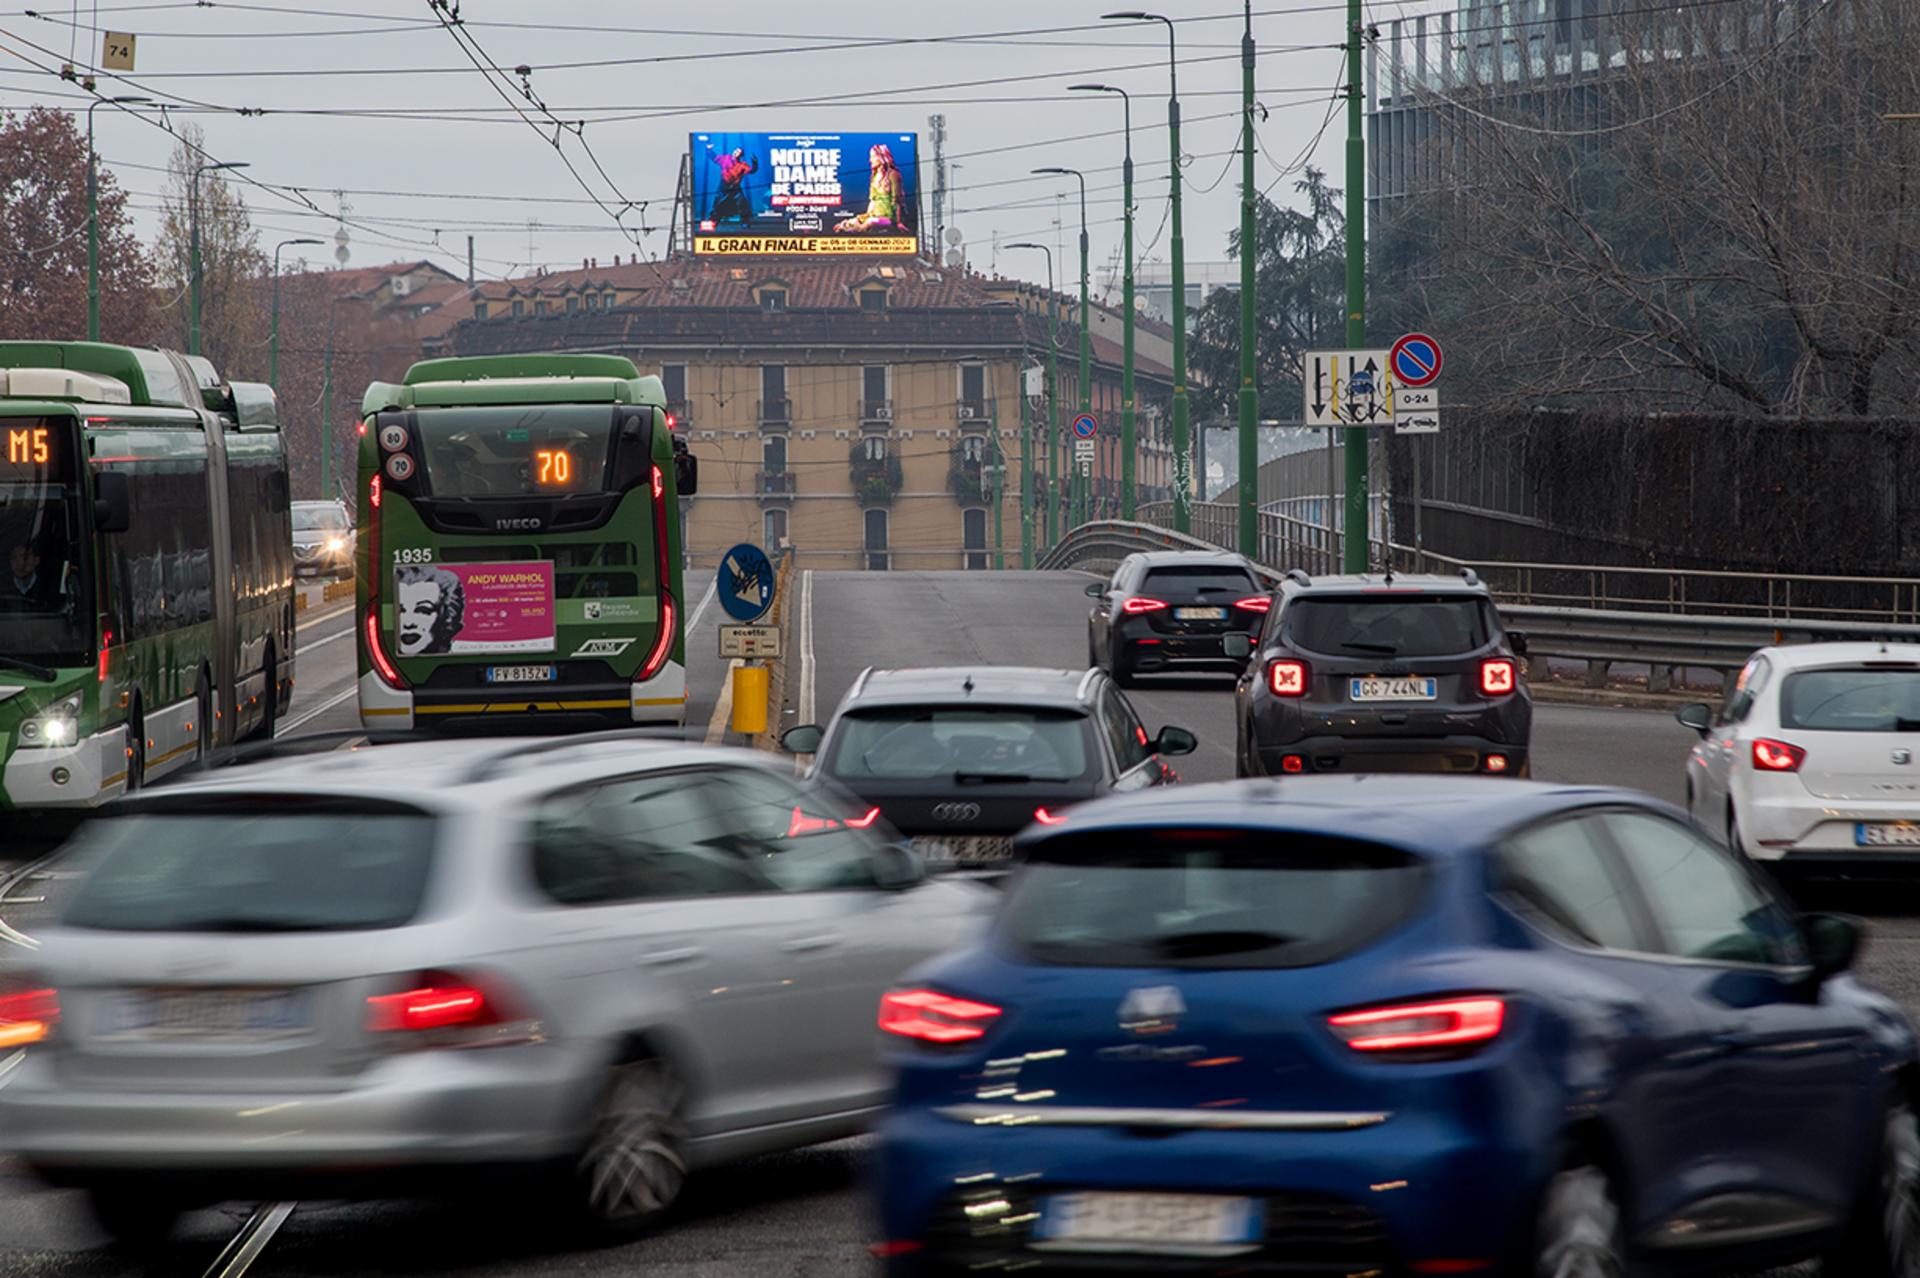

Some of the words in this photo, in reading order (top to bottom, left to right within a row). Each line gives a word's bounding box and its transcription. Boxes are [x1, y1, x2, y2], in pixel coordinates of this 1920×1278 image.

[109, 44, 128, 58] 74
[770, 148, 841, 166] NOTRE
[774, 166, 838, 183] DAME
[771, 183, 791, 195] DE
[794, 183, 841, 195] PARIS
[702, 240, 715, 251] IL
[718, 240, 760, 252] GRAN
[765, 240, 818, 252] FINALE
[1404, 394, 1429, 404] 0-24
[387, 433, 401, 444] 80
[9, 429, 48, 464] M5
[395, 460, 408, 473] 70
[537, 451, 569, 482] 70
[496, 518, 541, 529] IVECO
[393, 548, 432, 564] 1935
[467, 574, 498, 585] ANDY
[499, 573, 545, 584] WARHOL
